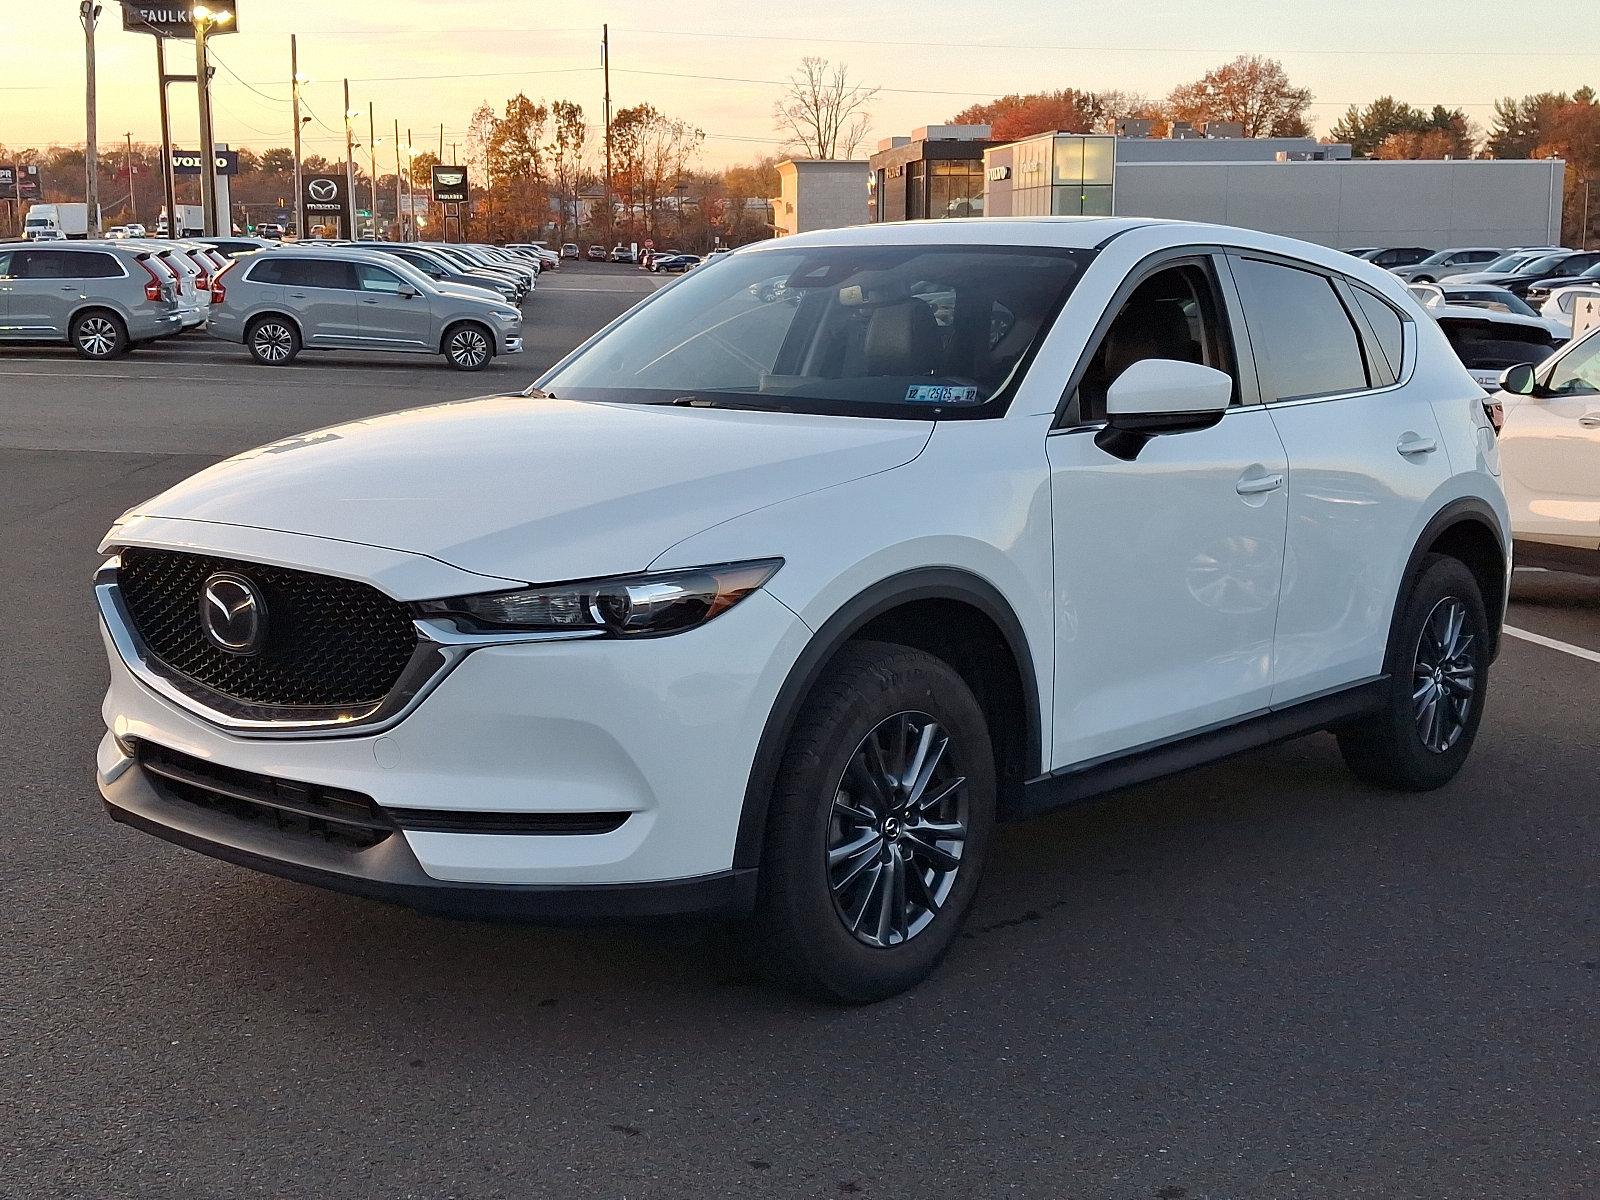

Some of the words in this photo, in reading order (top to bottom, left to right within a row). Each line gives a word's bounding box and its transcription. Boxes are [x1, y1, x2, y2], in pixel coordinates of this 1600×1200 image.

[140, 9, 192, 23] FAULK
[172, 157, 228, 168] VOLO
[0, 169, 12, 178] PR
[1473, 376, 1497, 386] MC
[908, 389, 919, 399] 12
[930, 388, 940, 399] 25
[943, 388, 952, 400] 25
